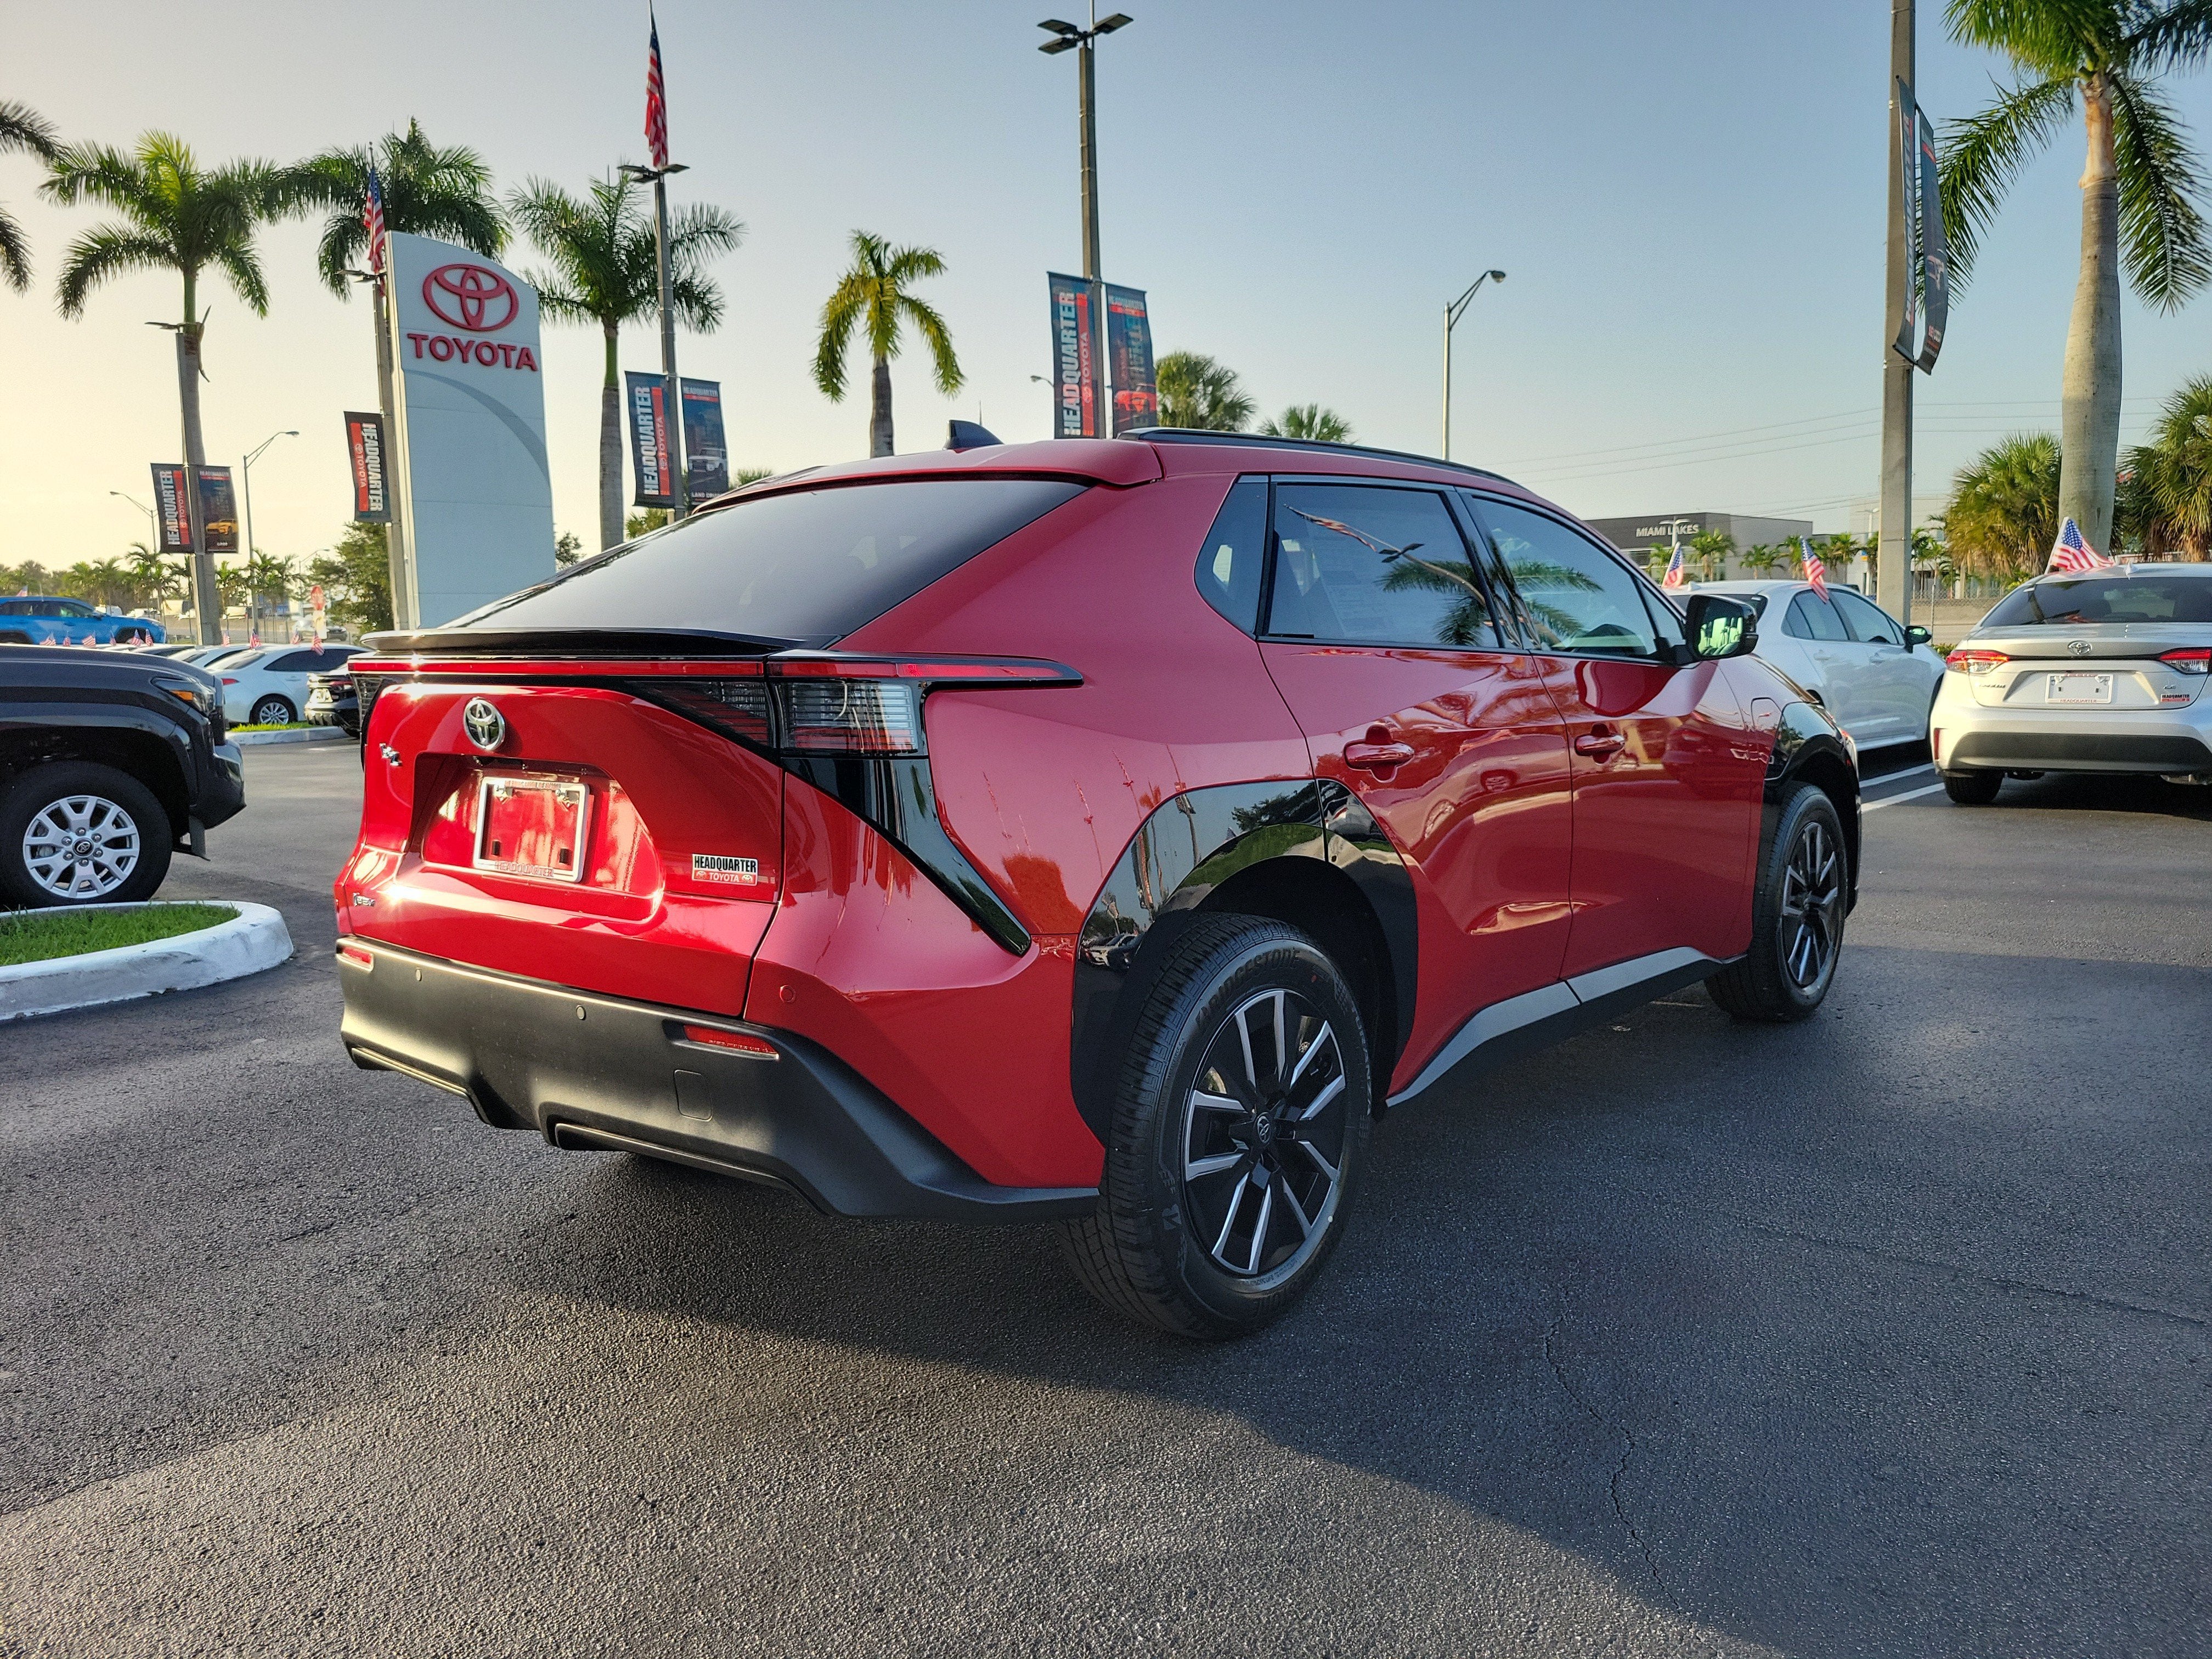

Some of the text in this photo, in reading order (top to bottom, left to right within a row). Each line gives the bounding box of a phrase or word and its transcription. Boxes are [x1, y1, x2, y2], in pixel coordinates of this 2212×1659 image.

[407, 332, 538, 372] TOYOTA
[1058, 291, 1081, 436] HEADQUARTER
[1080, 332, 1092, 387] TOYOTA
[634, 386, 659, 495] HEADQUARTER
[357, 453, 367, 488] TOYOTA
[362, 422, 383, 512] HEADQUARTER
[160, 470, 181, 545] HEADQUARTER
[1636, 526, 1666, 537] MIAMI
[694, 855, 757, 873] HEADQUARTER
[709, 872, 740, 883] TOYOTA
